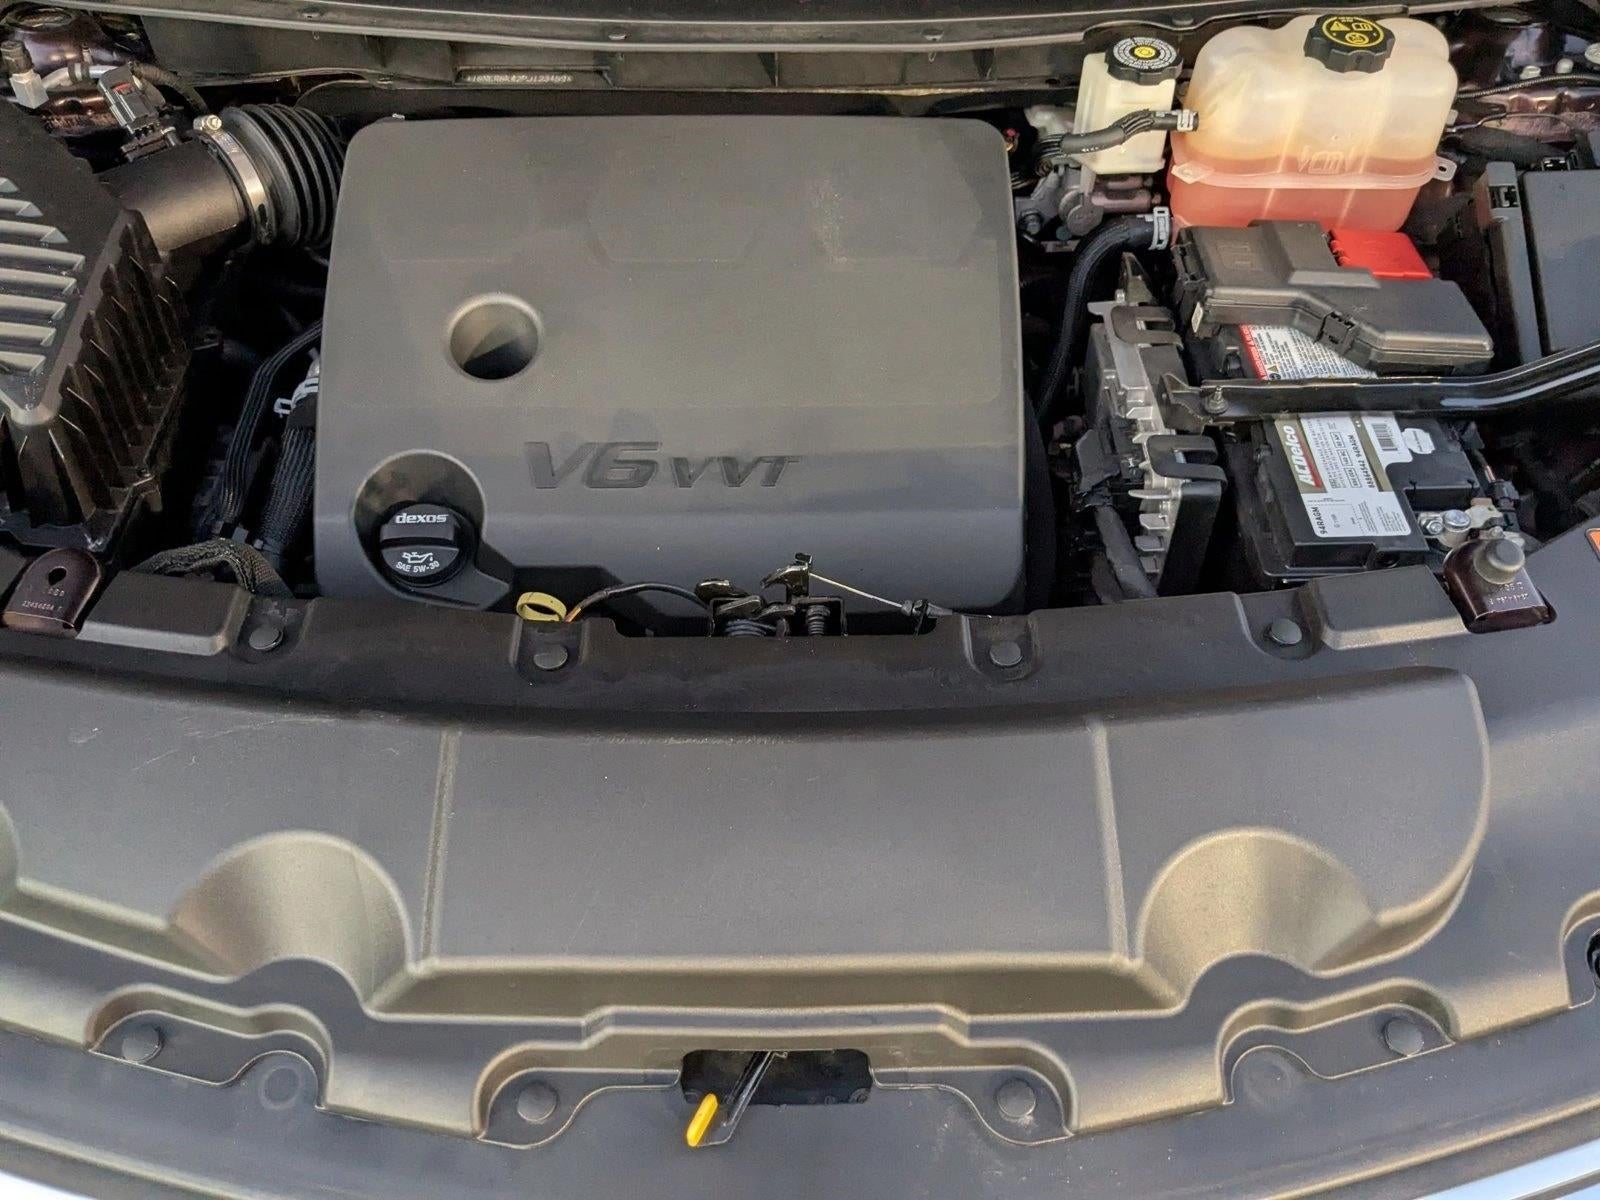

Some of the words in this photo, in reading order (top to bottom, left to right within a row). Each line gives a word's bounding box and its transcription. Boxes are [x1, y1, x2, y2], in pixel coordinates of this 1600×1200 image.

[1283, 425, 1316, 487] ACDelco
[1347, 434, 1362, 458] 94RAGM
[524, 441, 661, 489] V6
[670, 456, 804, 488] VVT
[395, 512, 449, 524] dexos
[1311, 506, 1328, 535] 94RAGM
[396, 561, 411, 572] SAE
[413, 560, 440, 573] 5W-30
